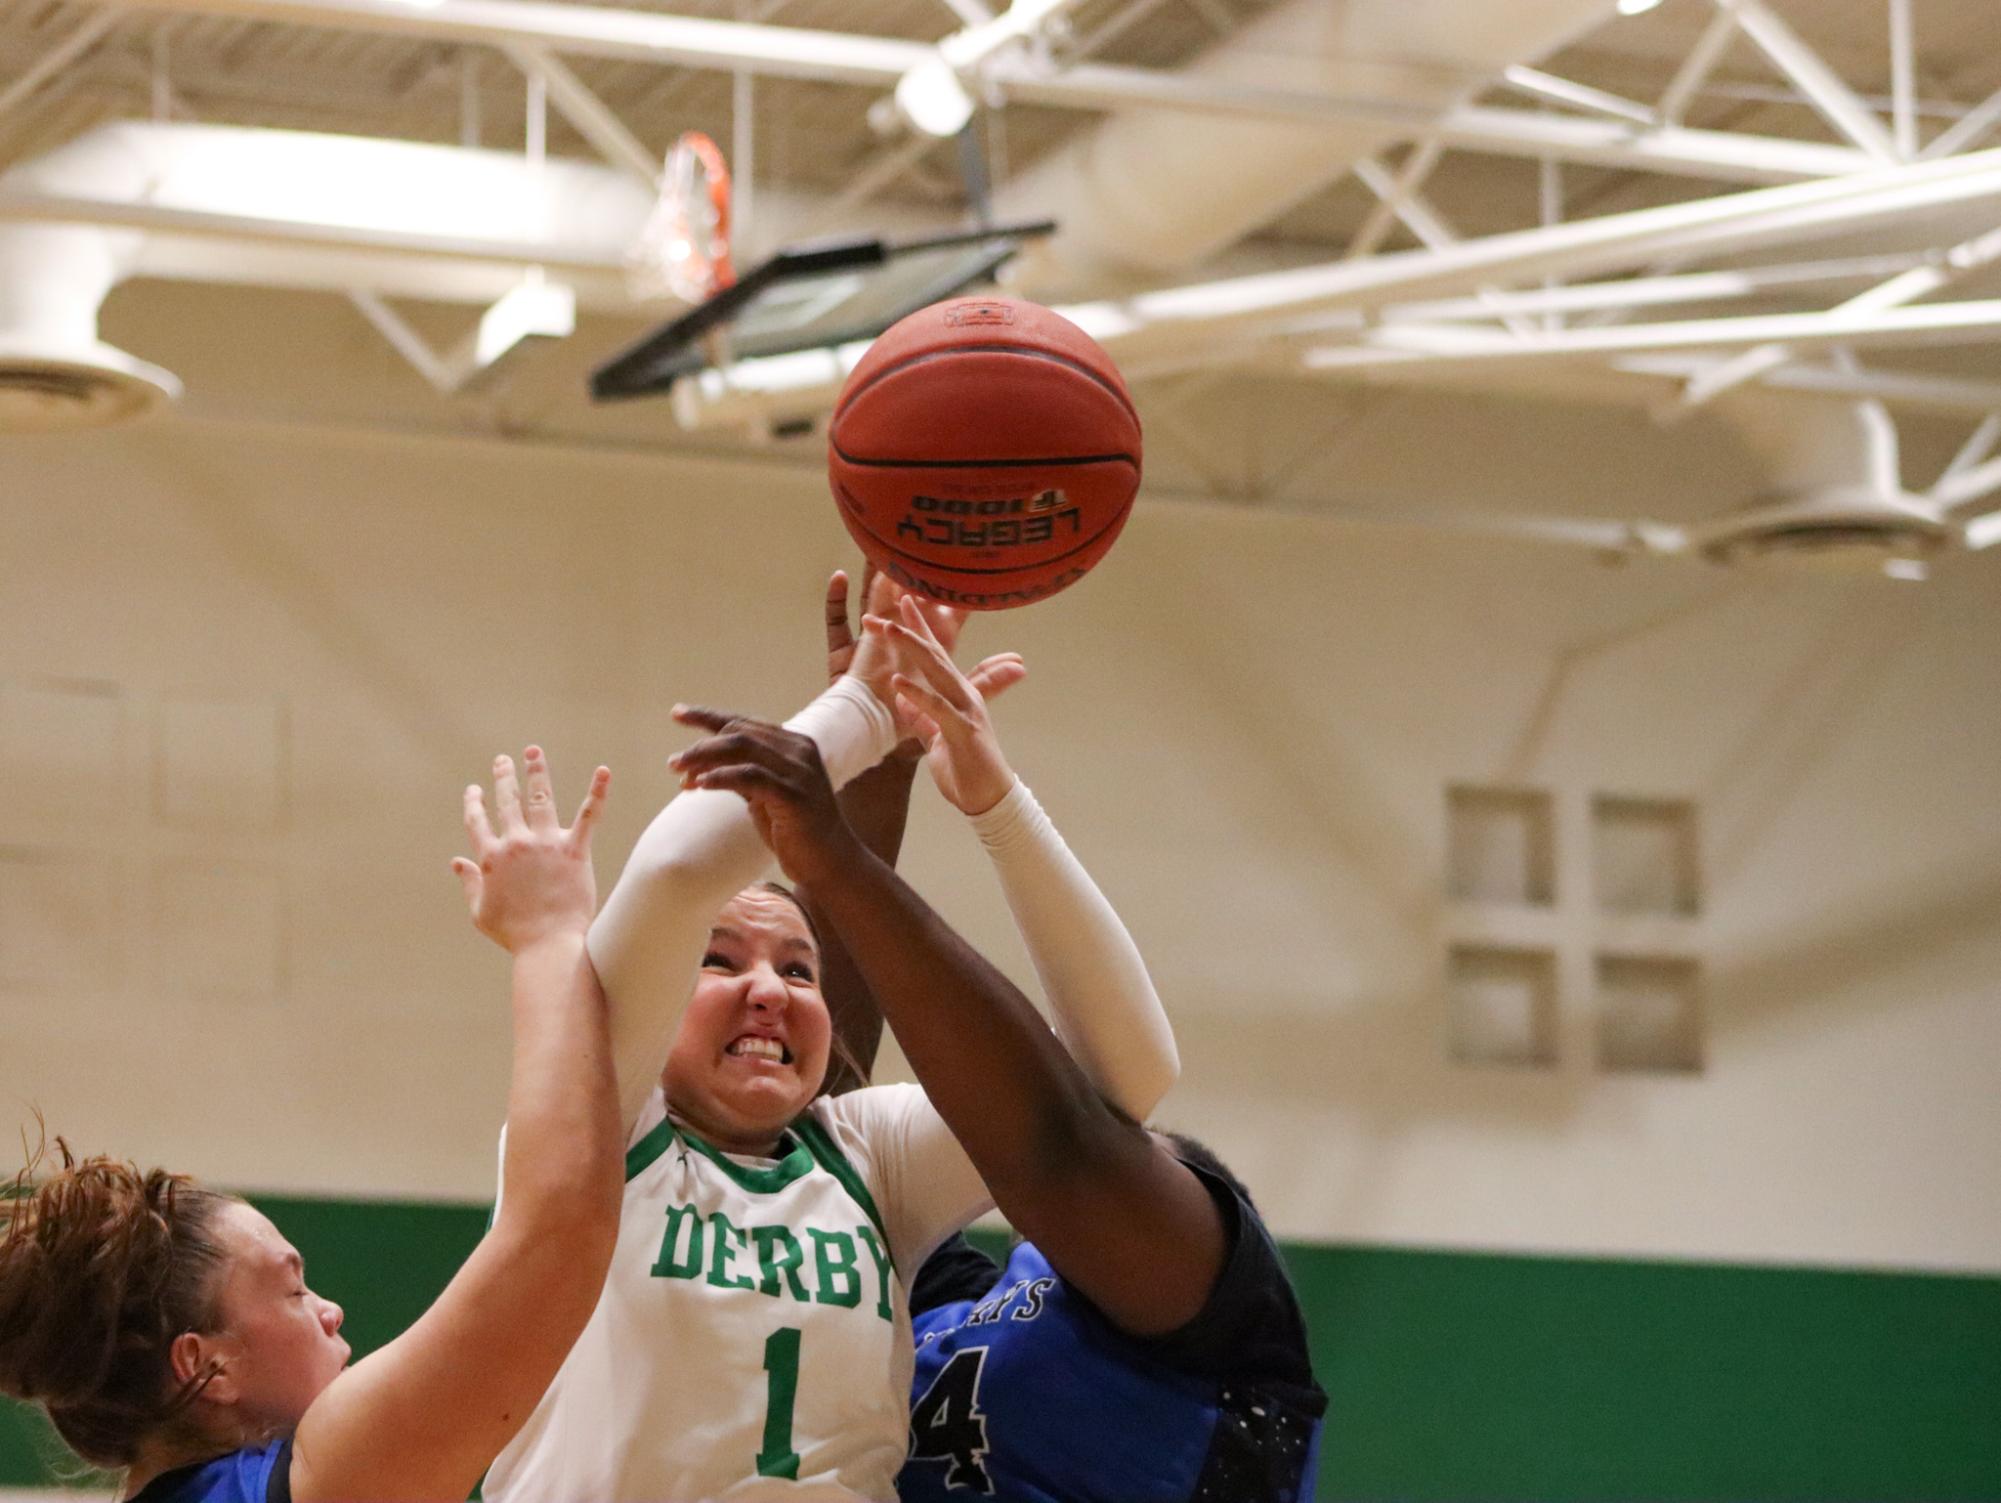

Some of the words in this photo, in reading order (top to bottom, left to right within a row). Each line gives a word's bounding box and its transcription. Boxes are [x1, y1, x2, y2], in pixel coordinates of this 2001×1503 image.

[896, 507, 1081, 547] LEGACY
[911, 495, 1025, 515] 1000
[650, 1203, 893, 1322] DERBY
[756, 1327, 802, 1480] 1
[908, 1345, 996, 1496] 4
